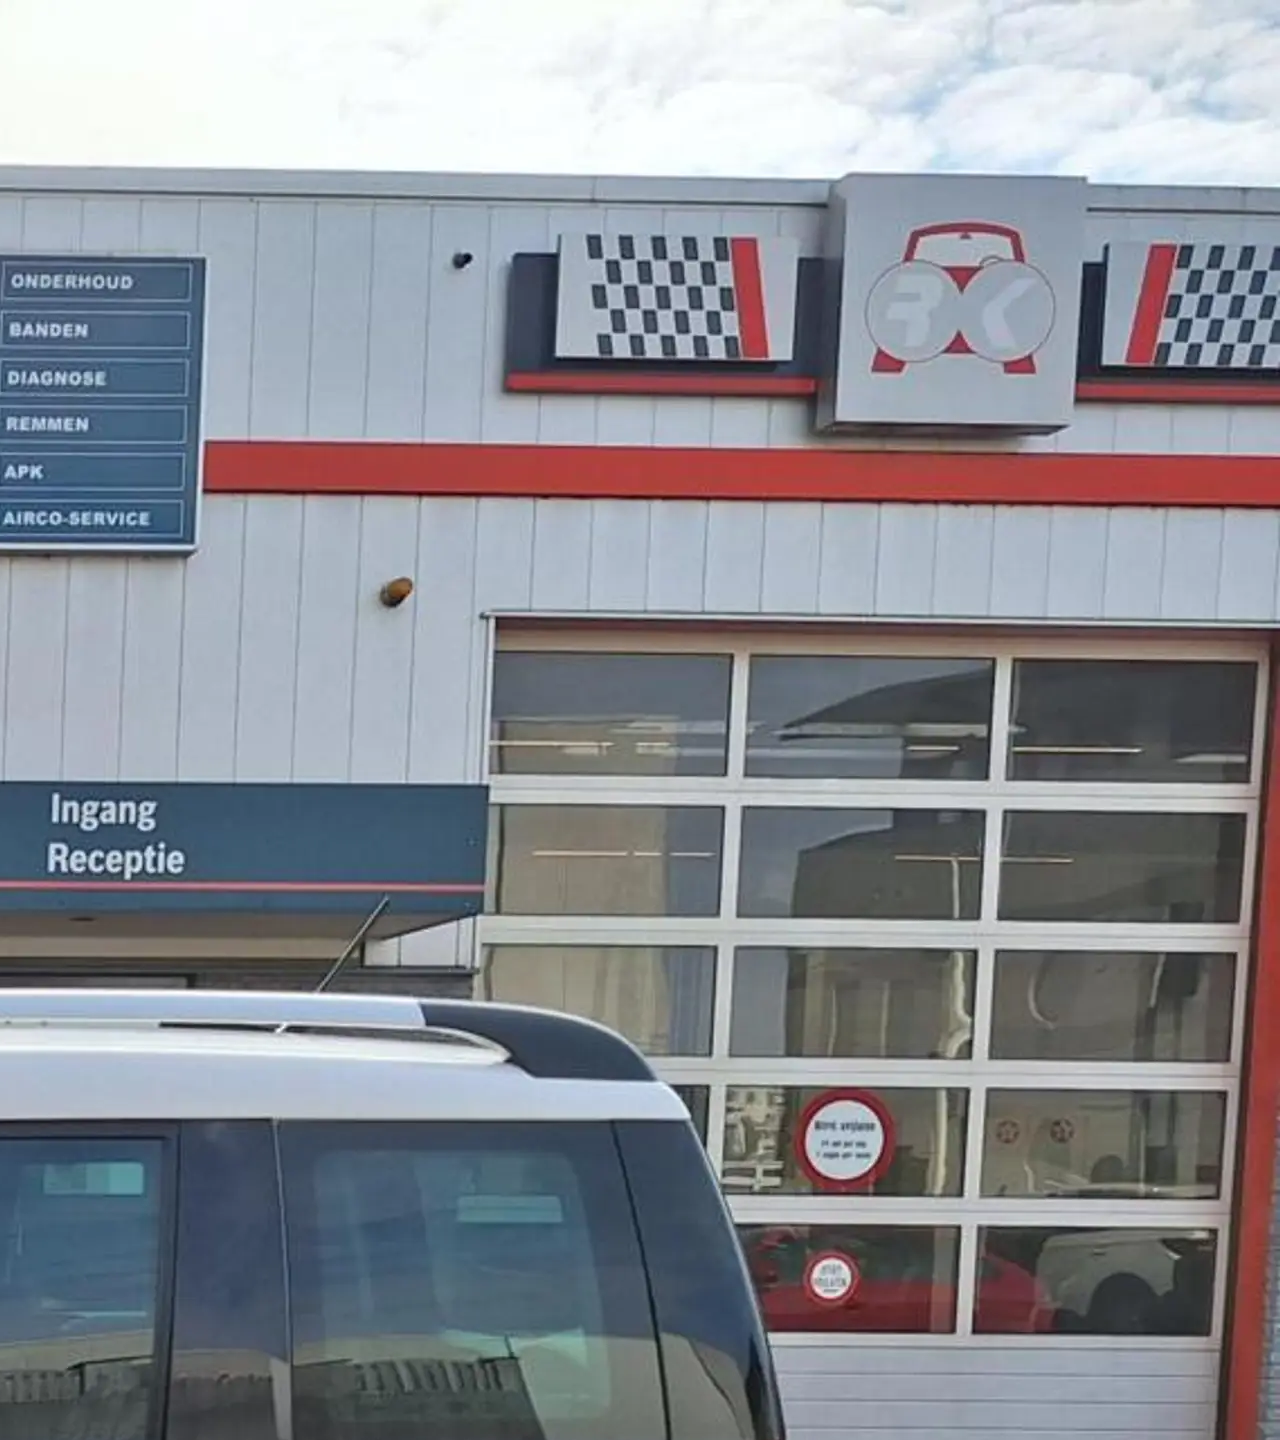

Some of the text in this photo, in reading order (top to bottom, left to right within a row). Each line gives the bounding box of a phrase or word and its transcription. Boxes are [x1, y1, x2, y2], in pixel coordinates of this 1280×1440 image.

[11, 273, 134, 290] ONDERHOUD
[8, 322, 89, 338] BANDEN
[7, 370, 107, 387] DIAGNOSE
[5, 416, 89, 432] REMMEN
[4, 464, 44, 480] APK
[2, 510, 151, 526] AIRCO-SERVICE
[51, 792, 158, 831] Ingang
[47, 841, 185, 880] Receptie
